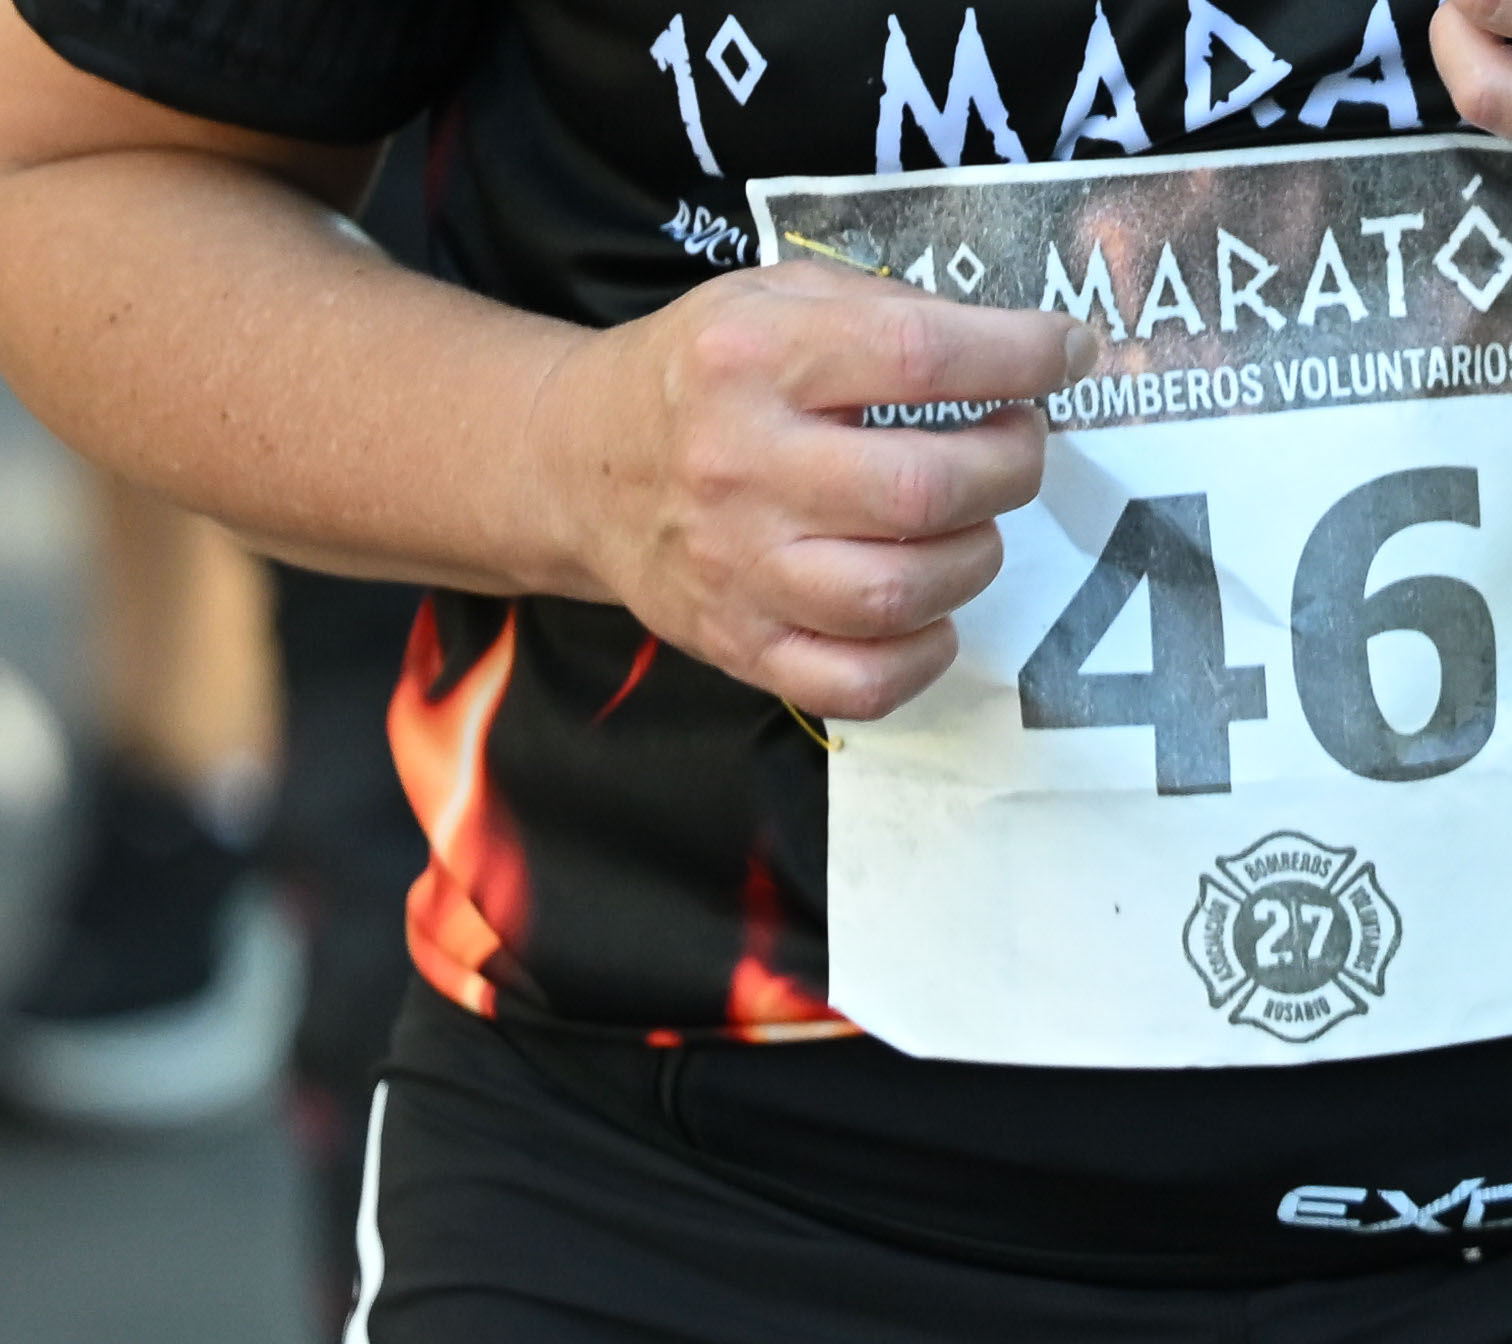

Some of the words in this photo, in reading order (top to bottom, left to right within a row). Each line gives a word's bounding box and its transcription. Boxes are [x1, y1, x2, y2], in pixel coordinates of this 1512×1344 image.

[1047, 359, 1263, 424] BOMBEROS
[1018, 466, 1498, 796] 46
[1244, 851, 1333, 882] BOMBEROS
[1252, 897, 1335, 968] 27
